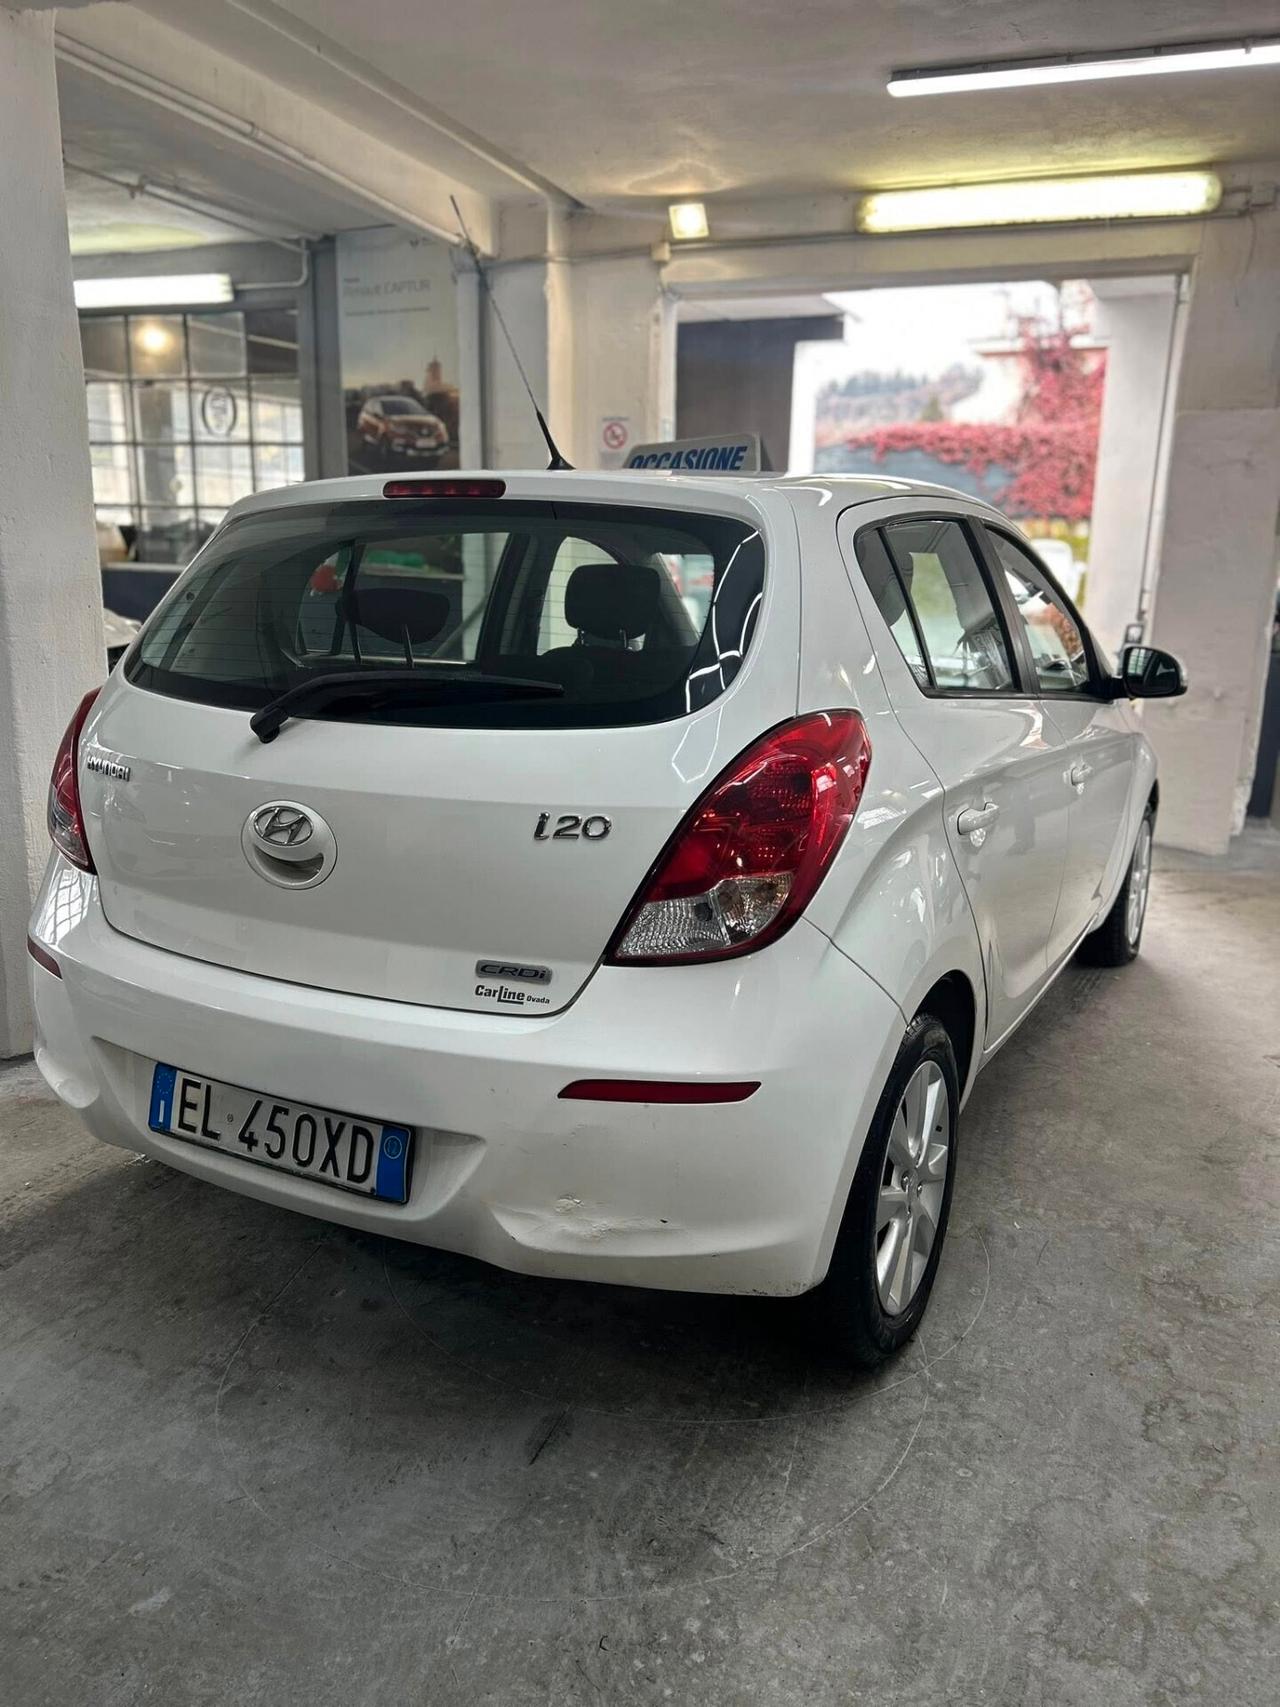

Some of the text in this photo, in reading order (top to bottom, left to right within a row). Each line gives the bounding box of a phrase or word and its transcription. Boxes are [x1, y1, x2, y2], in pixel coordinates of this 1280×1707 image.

[630, 445, 748, 471] OCCASIONE
[534, 811, 612, 841] i20
[480, 964, 547, 980] CRDi
[475, 984, 551, 1005] CarLine Ovada
[177, 1077, 221, 1141] EL
[238, 1099, 375, 1184] 450XD
